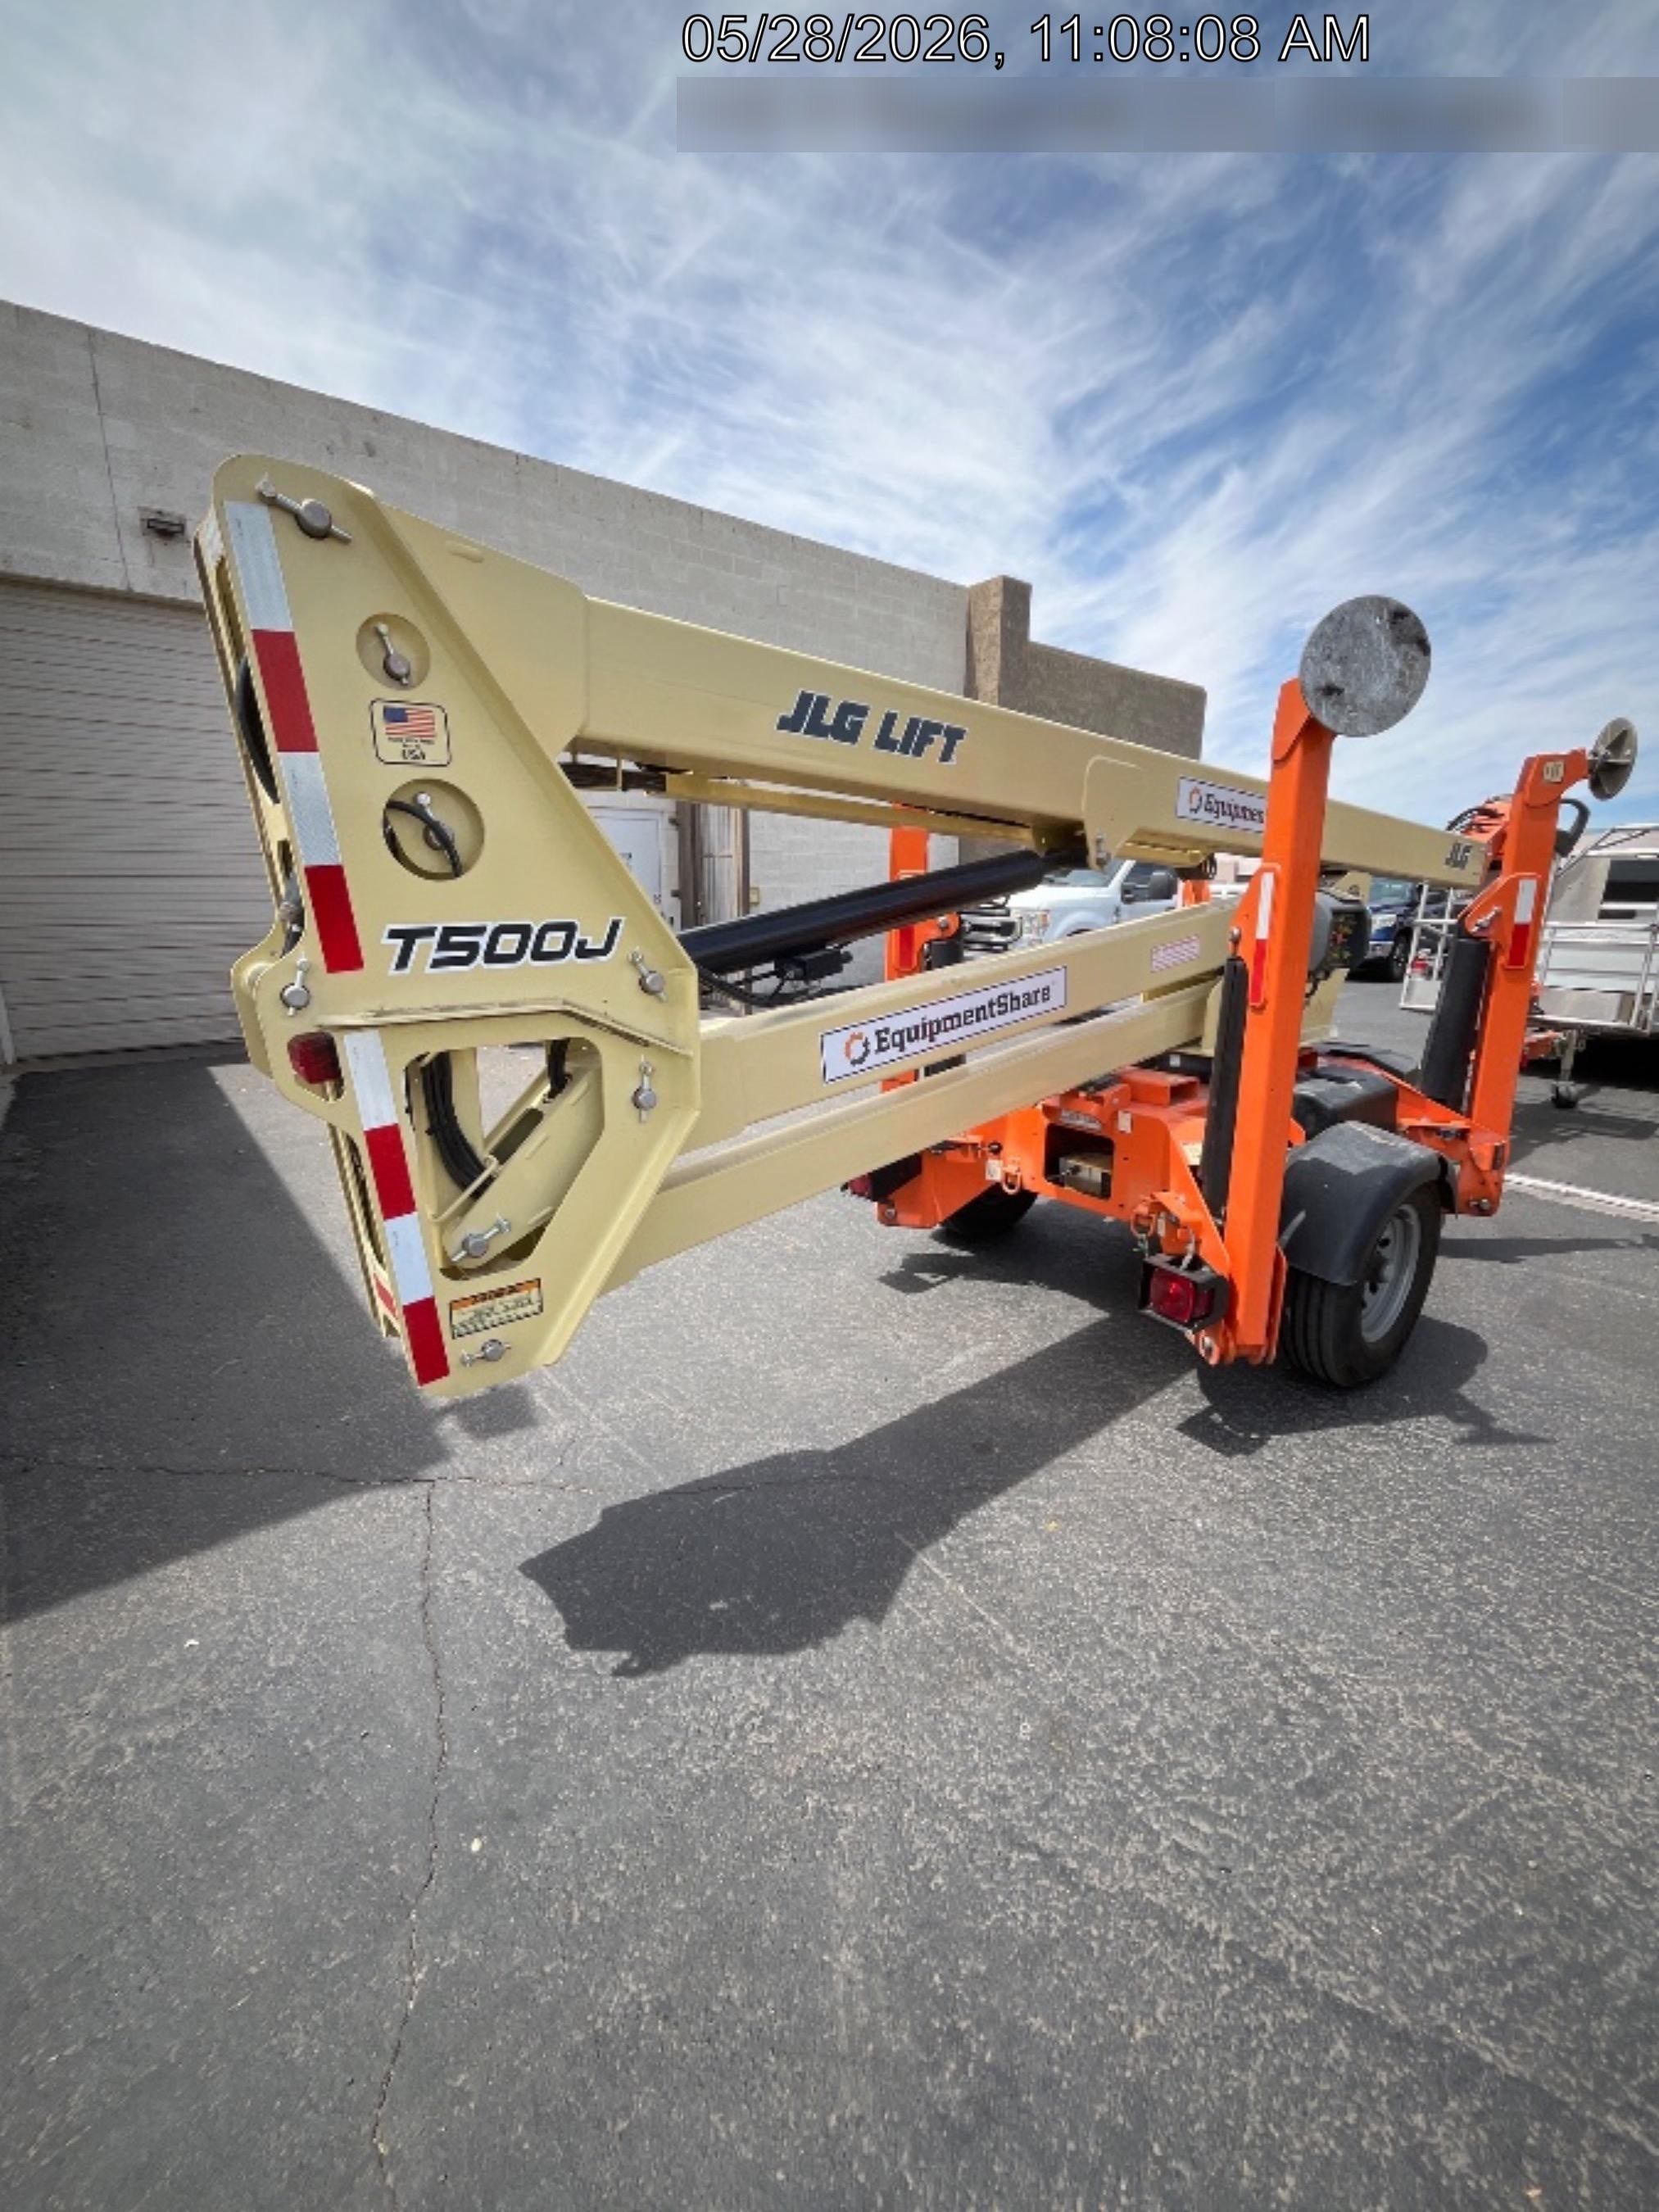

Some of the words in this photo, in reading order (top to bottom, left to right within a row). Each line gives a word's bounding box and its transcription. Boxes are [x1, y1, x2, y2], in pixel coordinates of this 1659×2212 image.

[777, 689, 870, 746] JLG
[873, 710, 968, 764] LIFT
[383, 917, 625, 974] T500J
[874, 984, 1051, 1053] EquipmentShare
